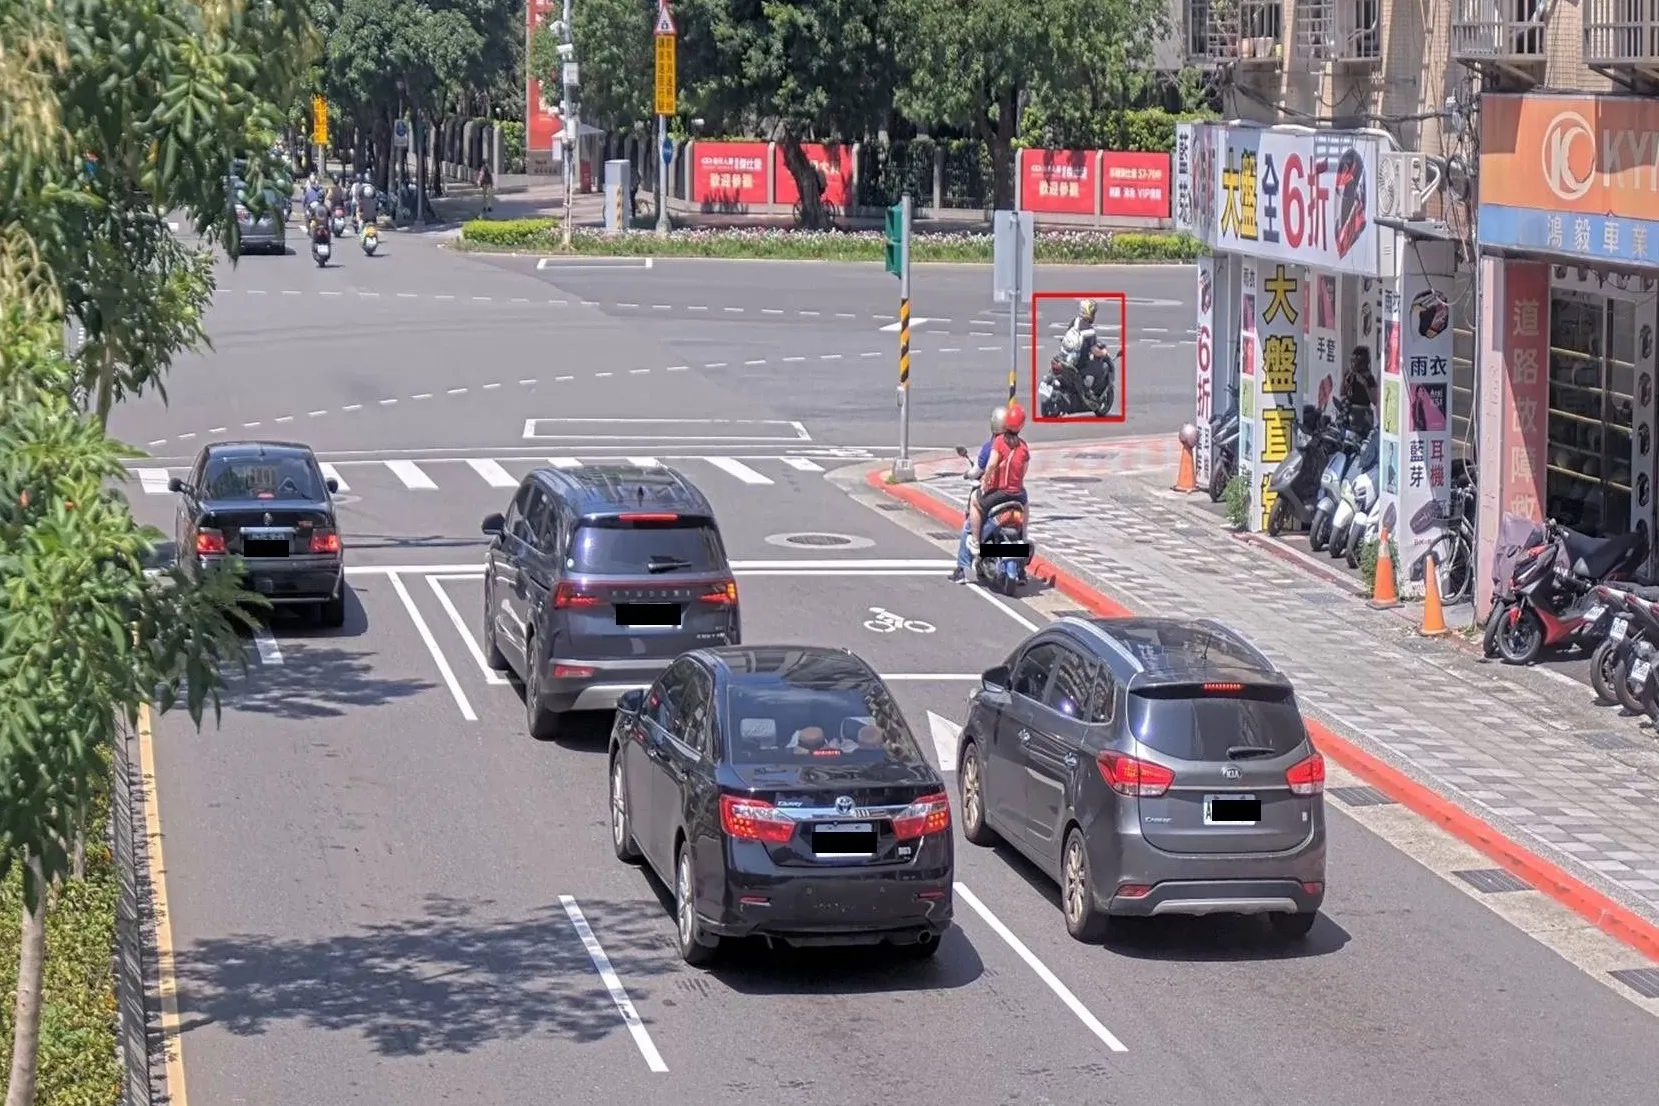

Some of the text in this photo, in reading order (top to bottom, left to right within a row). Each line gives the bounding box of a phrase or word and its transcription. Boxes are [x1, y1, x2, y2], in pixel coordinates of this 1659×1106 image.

[1196, 326, 1212, 422] 6折
[1410, 355, 1447, 377] 雨衣
[1410, 440, 1424, 488] 藍芽
[1431, 440, 1444, 488] 耳機
[1225, 768, 1242, 779] KIA
